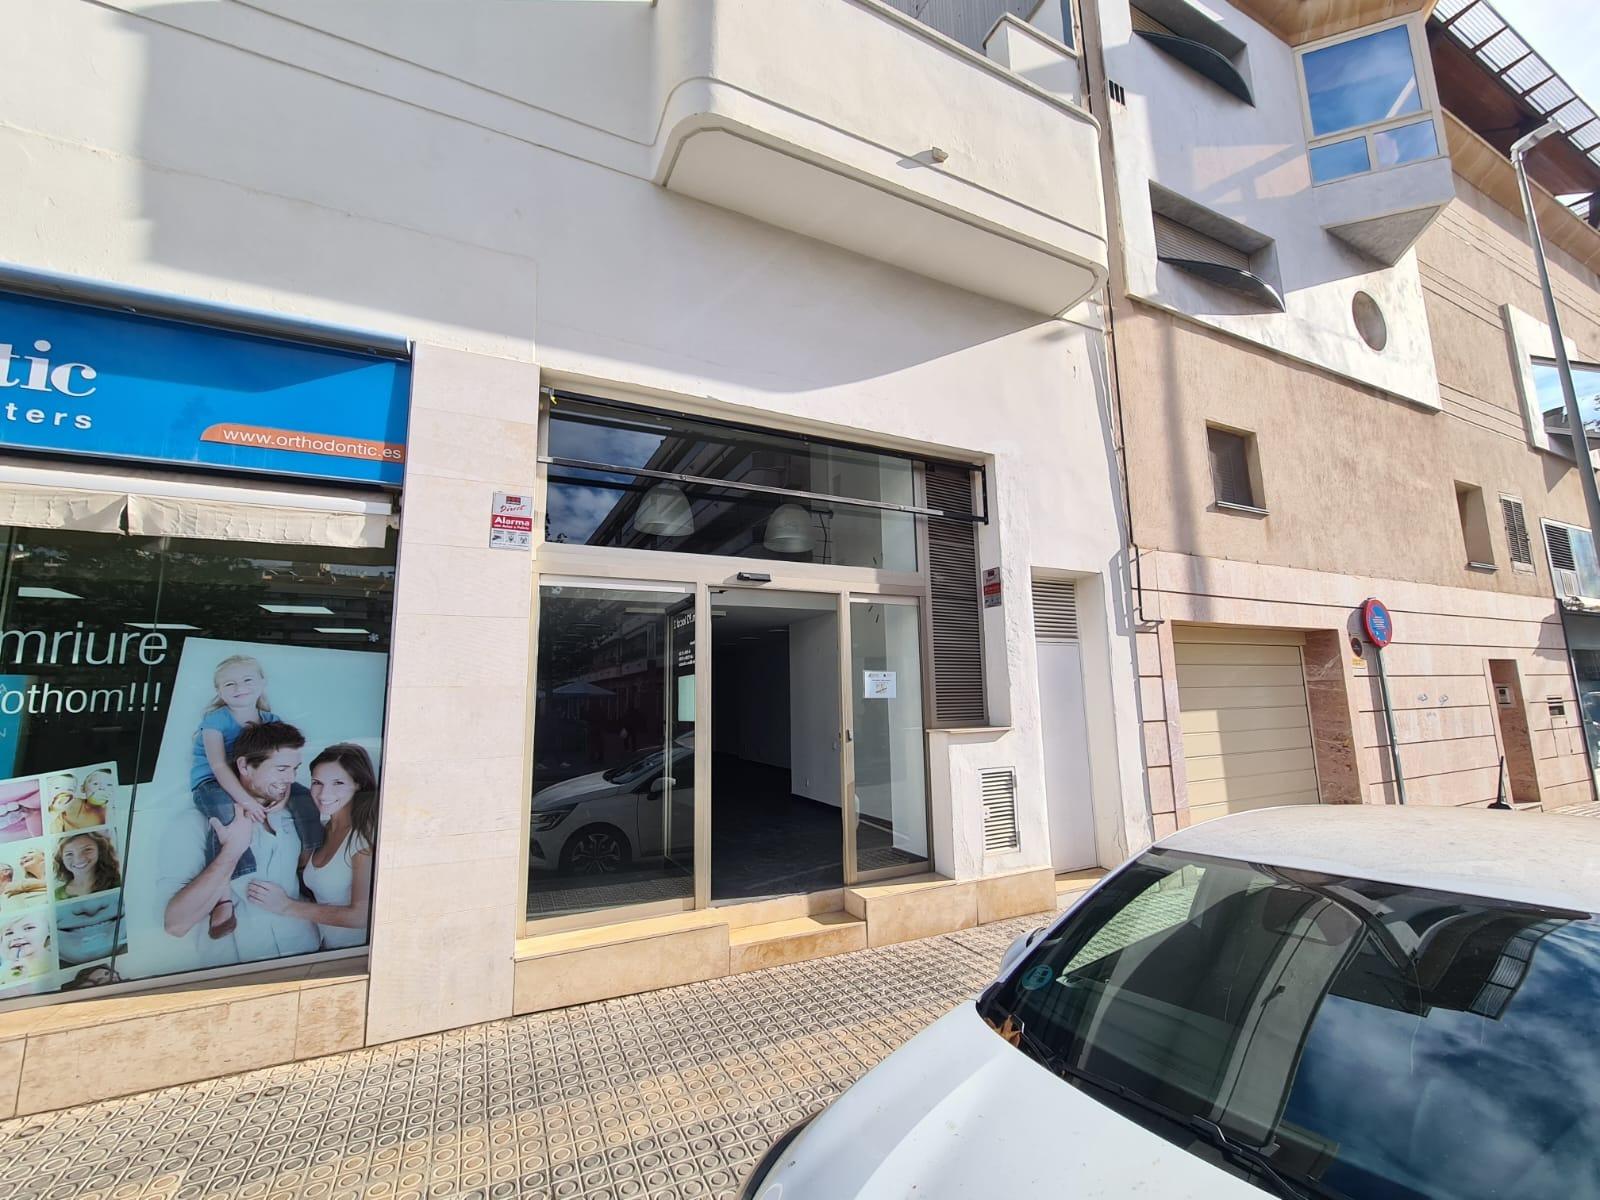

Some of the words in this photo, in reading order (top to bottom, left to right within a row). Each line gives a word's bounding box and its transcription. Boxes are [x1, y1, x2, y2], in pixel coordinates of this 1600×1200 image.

[0, 339, 97, 397] tic
[5, 402, 93, 429] ters
[223, 429, 402, 460] www.orthodontic.es
[494, 516, 530, 527] Alarma
